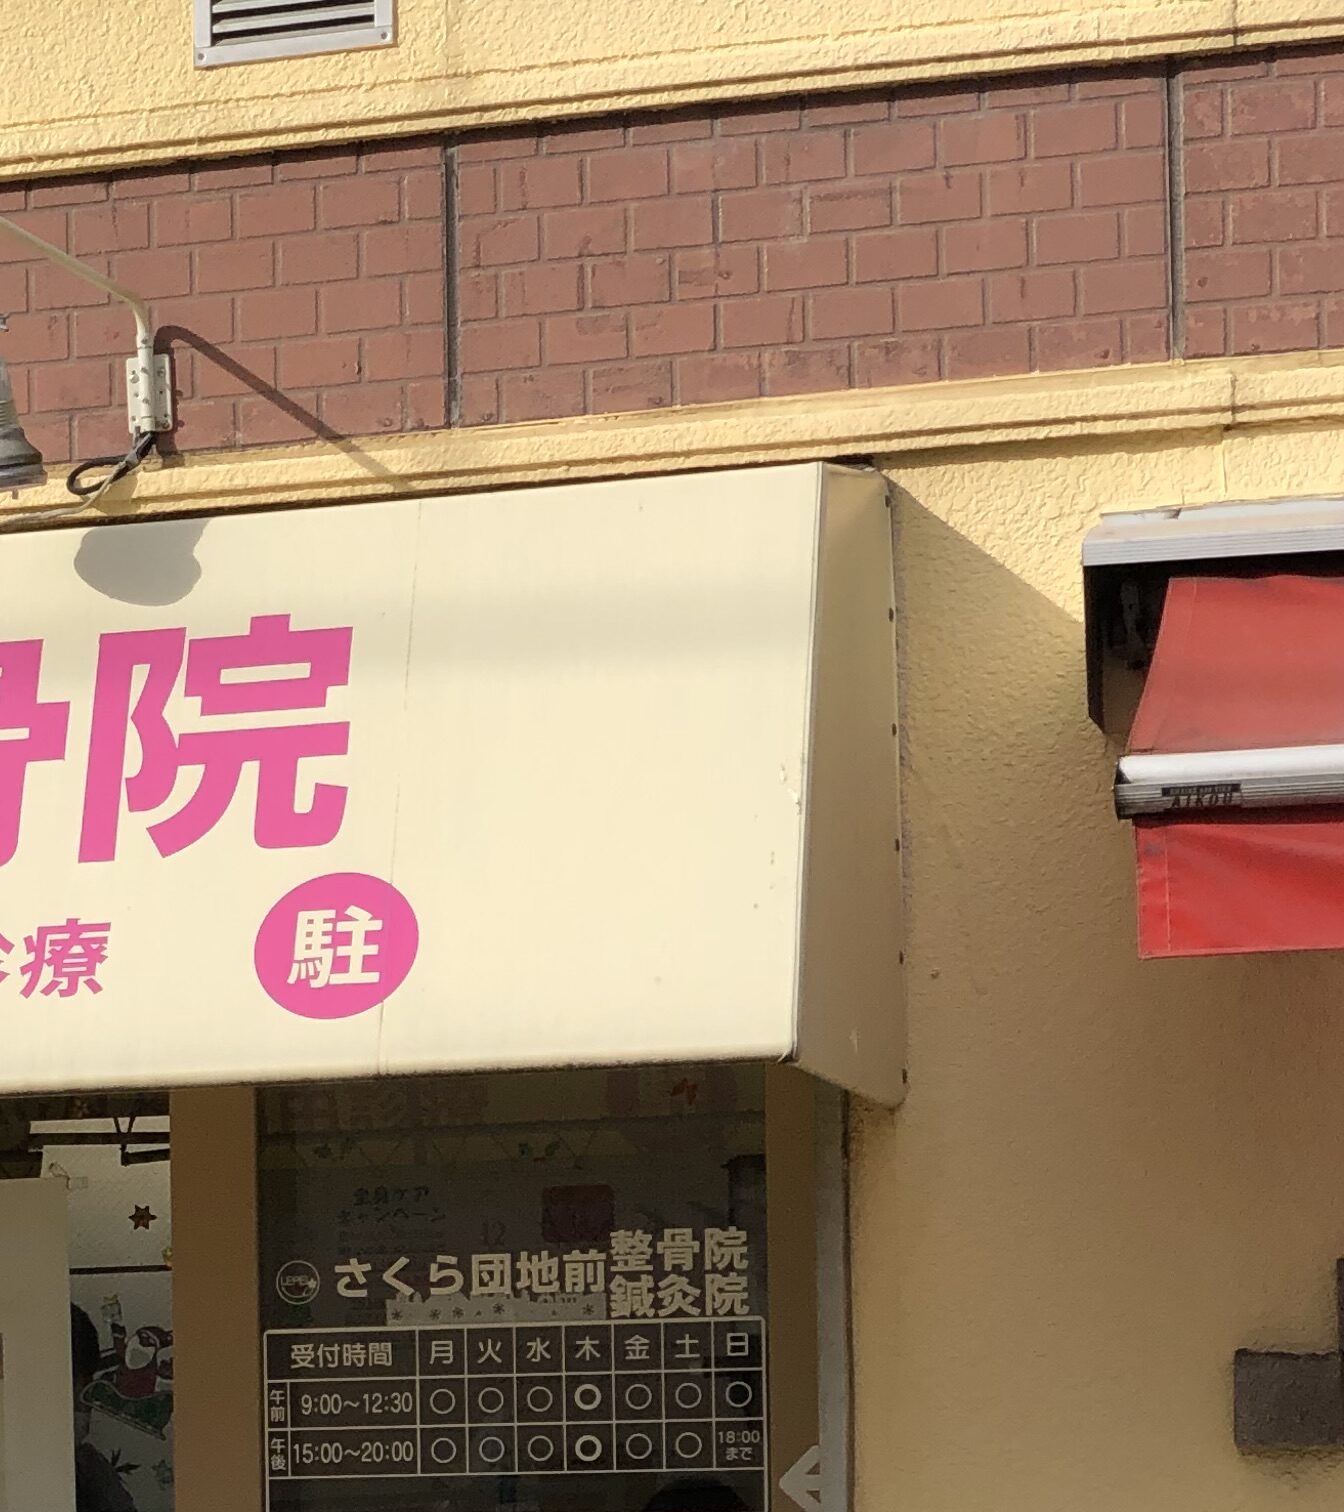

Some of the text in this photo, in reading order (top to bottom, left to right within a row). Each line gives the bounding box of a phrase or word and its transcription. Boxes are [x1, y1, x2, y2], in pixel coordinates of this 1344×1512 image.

[285, 904, 386, 993] 駐
[610, 1226, 749, 1274] 整骨院
[334, 1250, 606, 1298] さくら団地前
[610, 1273, 750, 1318] 鍼灸院
[290, 1331, 750, 1369] 受付時間 月 火 水 木 金 土 日
[717, 1430, 761, 1445] 18:00
[725, 1446, 753, 1462] まで
